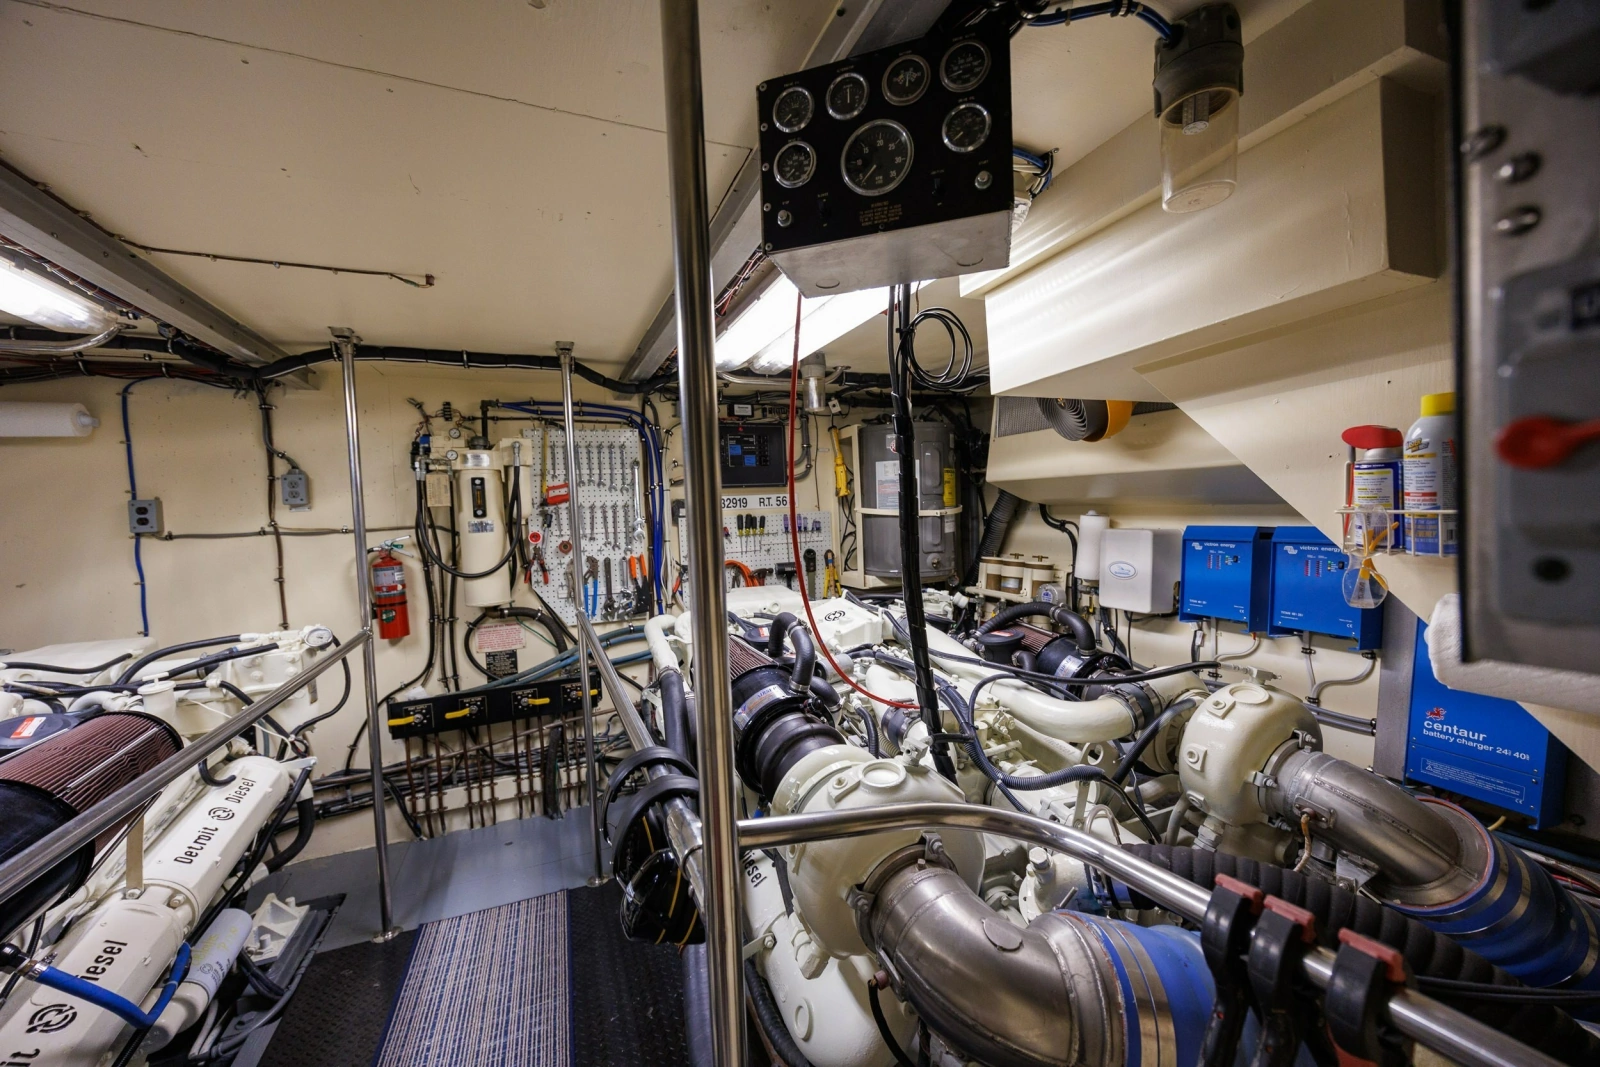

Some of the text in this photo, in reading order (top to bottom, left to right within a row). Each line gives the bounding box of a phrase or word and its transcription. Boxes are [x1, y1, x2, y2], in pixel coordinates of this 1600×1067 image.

[876, 139, 884, 147] 20
[888, 143, 896, 151] 25
[863, 146, 870, 154] 15
[894, 156, 902, 164] 30
[889, 170, 897, 178] 35
[758, 496, 773, 507] R.T.
[775, 496, 788, 507] 56
[1423, 720, 1487, 742] centaur
[1423, 728, 1455, 743] battery
[1456, 738, 1494, 752] charger
[173, 777, 257, 865] Detroit Diesel
[741, 849, 768, 888] iesel
[75, 939, 128, 982] iesel
